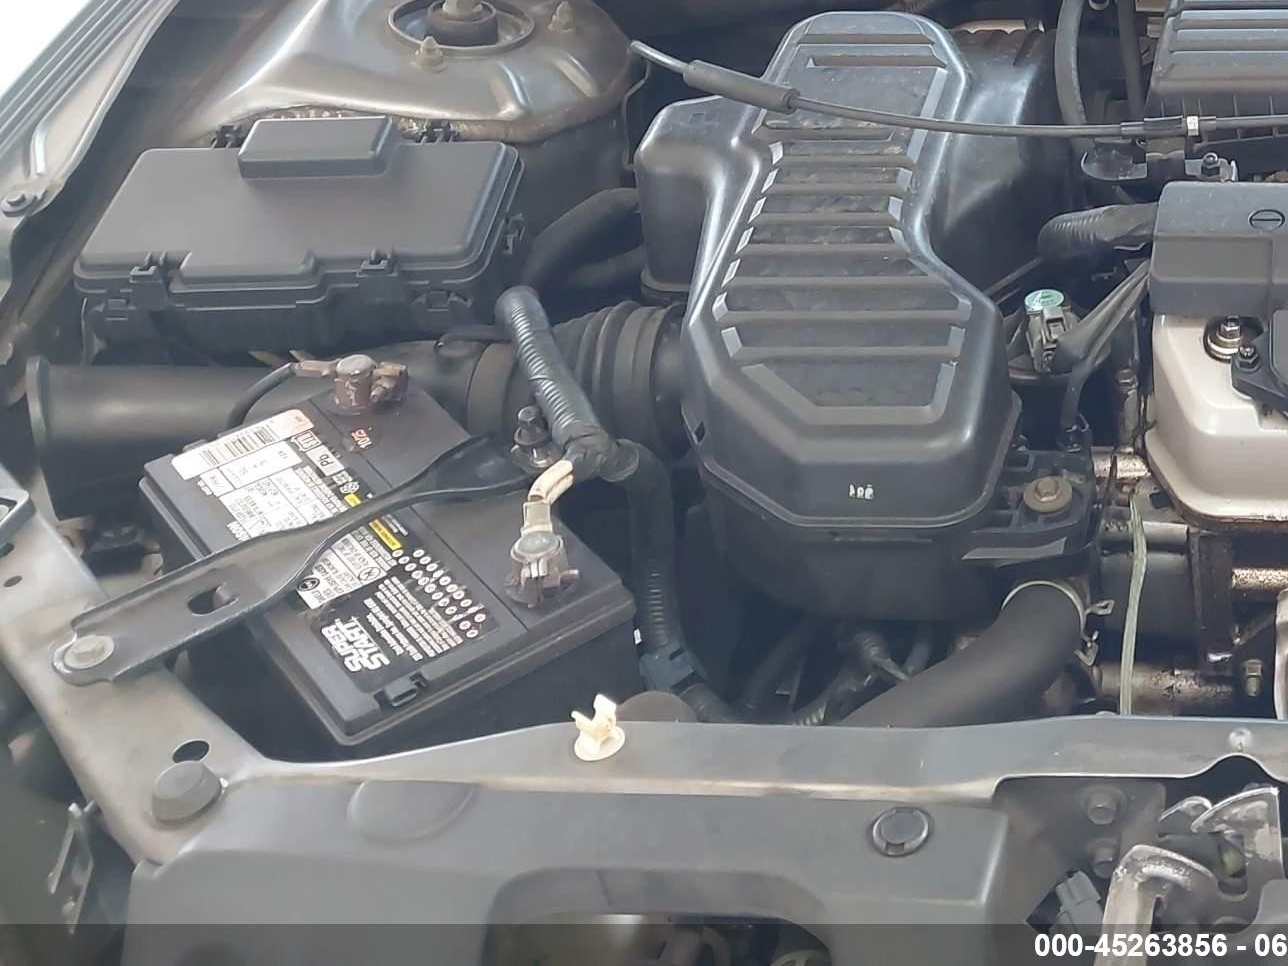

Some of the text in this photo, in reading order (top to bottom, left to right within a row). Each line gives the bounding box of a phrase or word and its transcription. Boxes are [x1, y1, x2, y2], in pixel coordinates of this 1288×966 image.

[318, 453, 334, 467] Pb
[321, 624, 364, 672] SUPER
[334, 617, 390, 670] START
